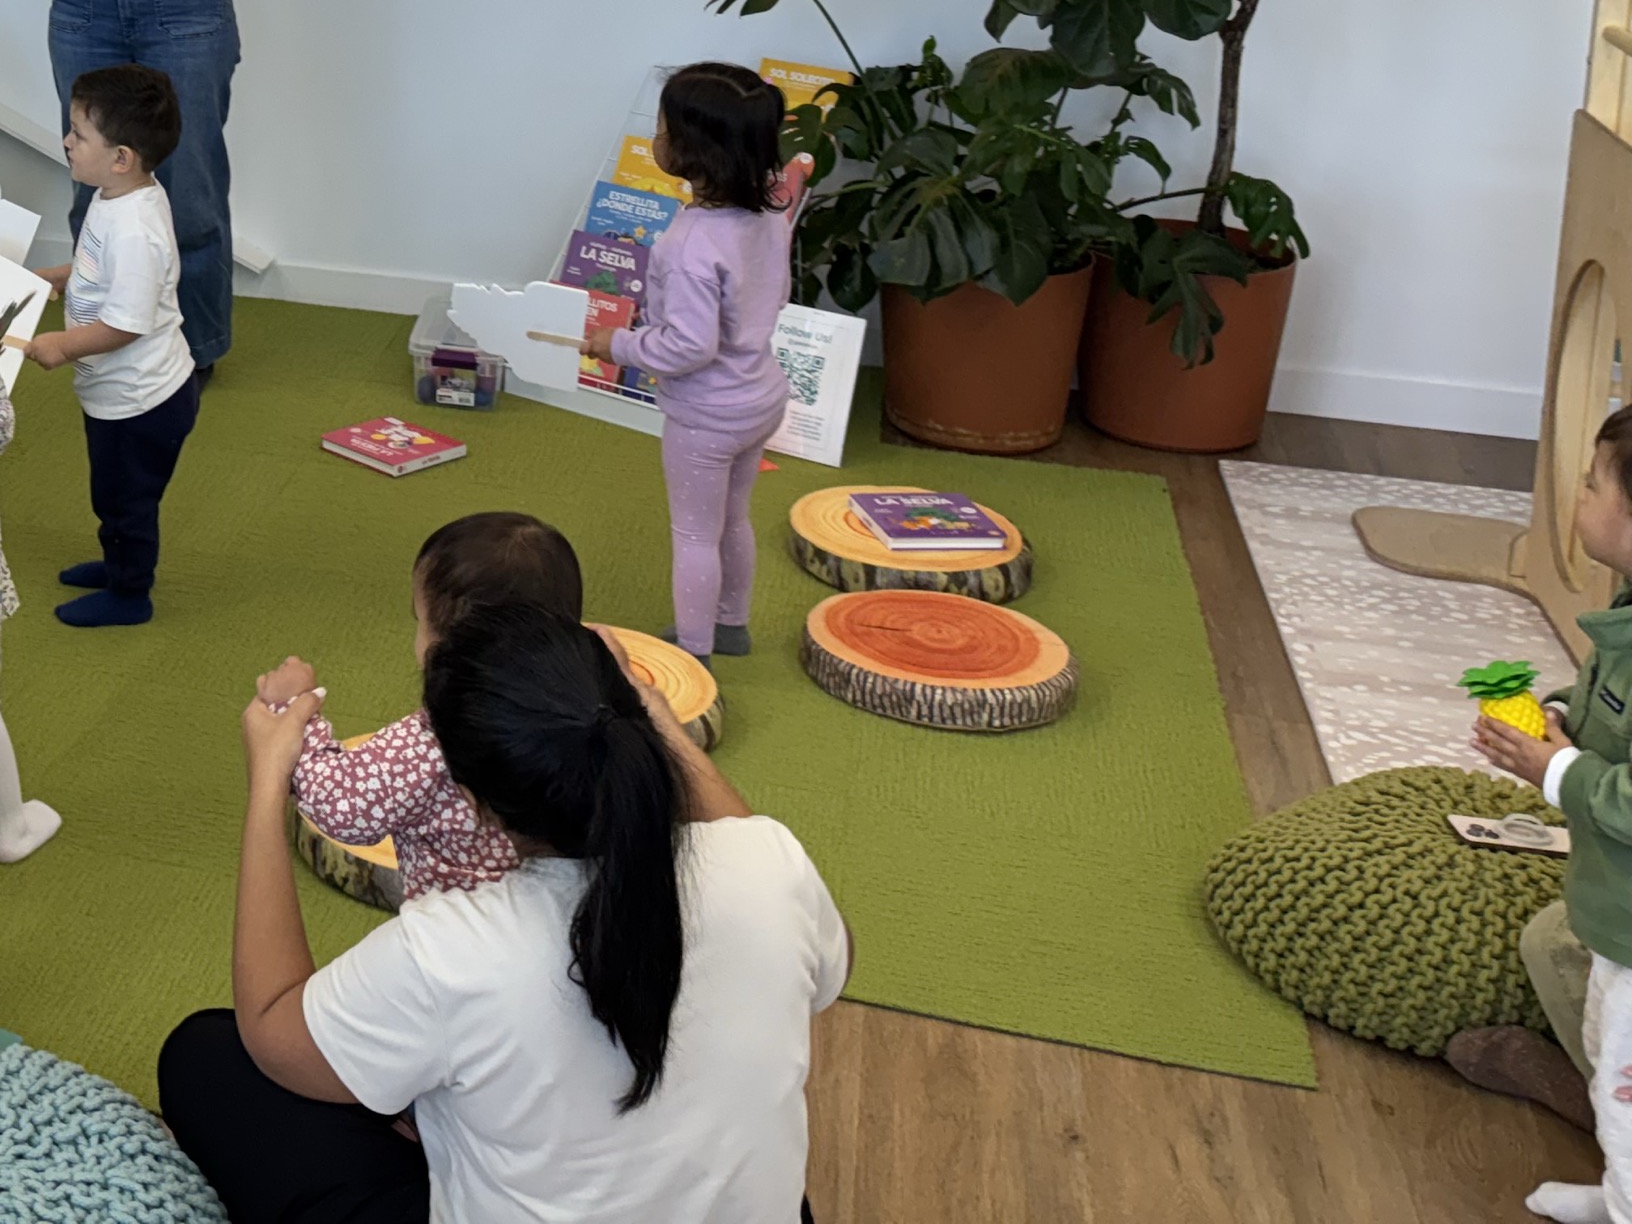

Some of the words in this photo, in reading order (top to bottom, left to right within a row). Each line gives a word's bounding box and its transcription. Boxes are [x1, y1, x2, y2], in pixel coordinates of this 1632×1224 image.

[789, 71, 835, 87] SOLECIT
[609, 191, 659, 210] ESTRELLITA
[580, 246, 596, 261] LA
[598, 251, 636, 271] SELVA
[778, 324, 812, 339] Follow
[900, 498, 955, 506] SELVA
